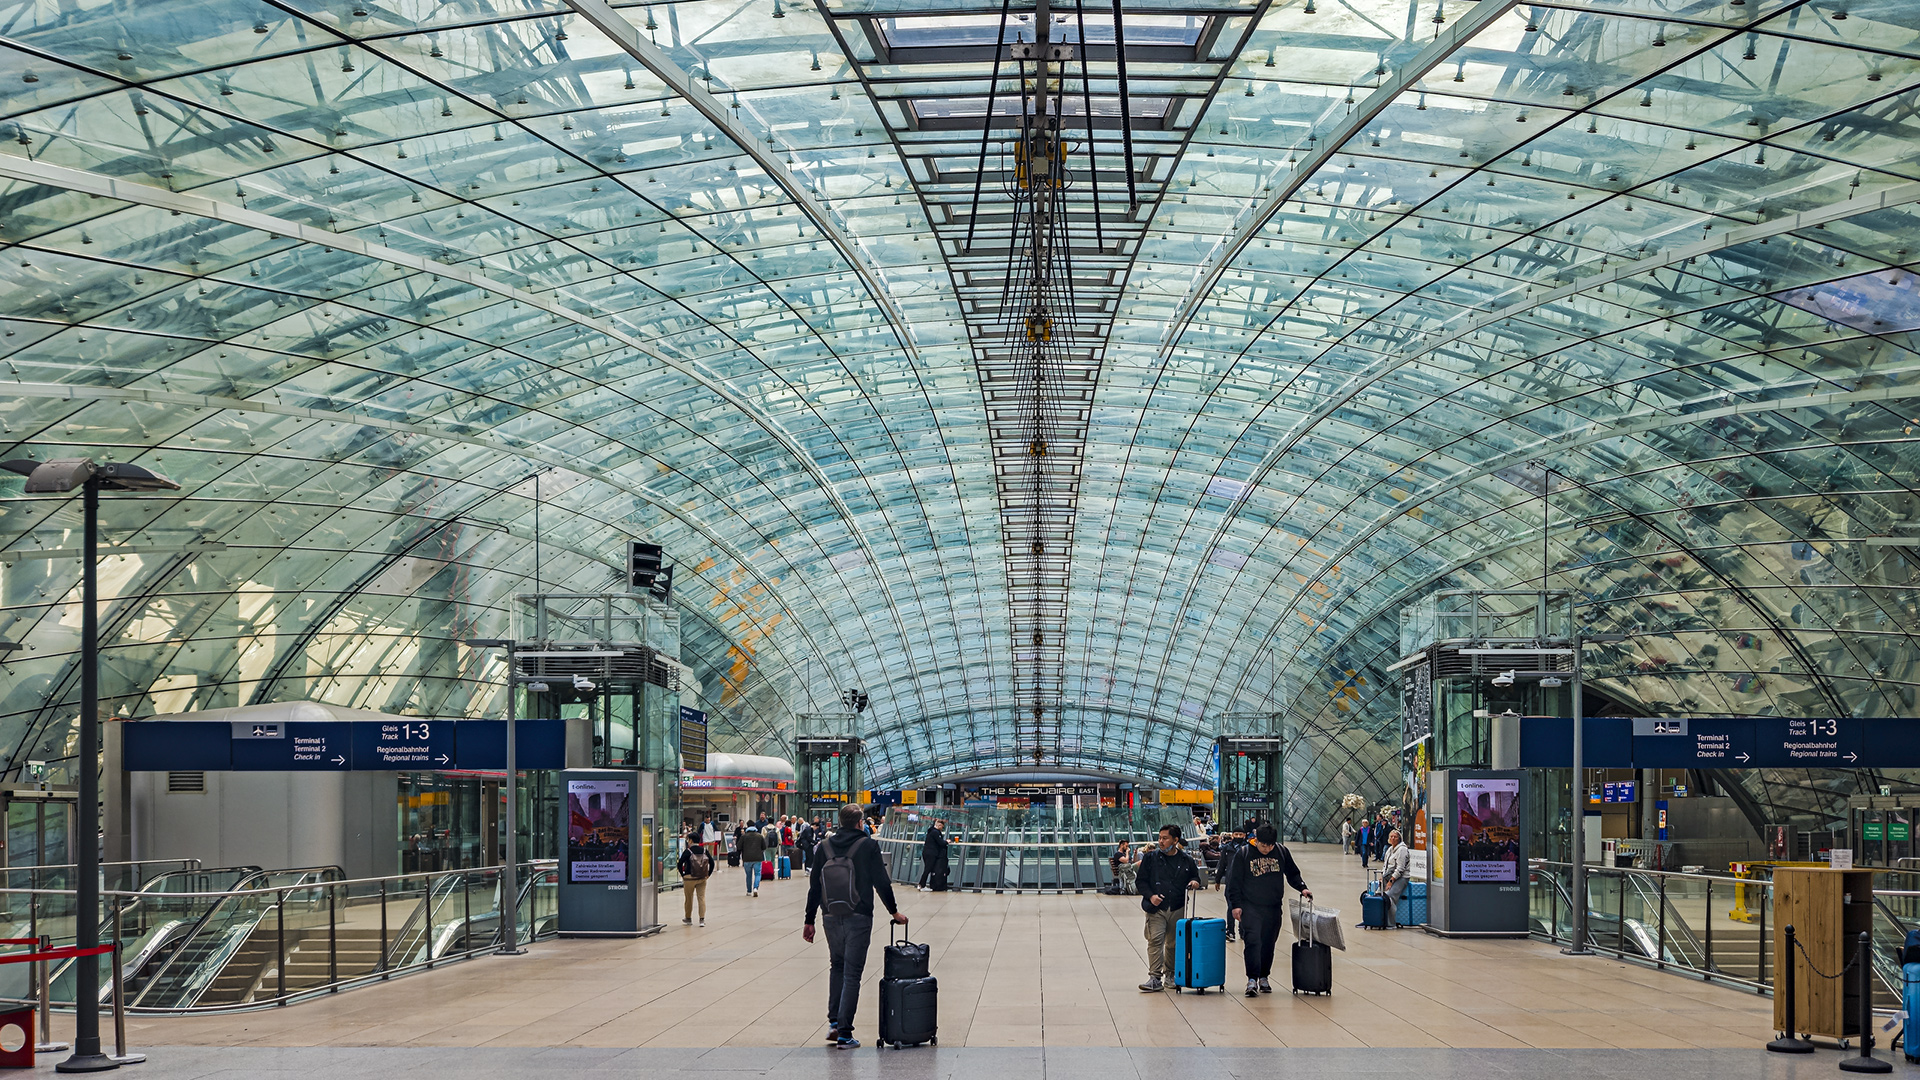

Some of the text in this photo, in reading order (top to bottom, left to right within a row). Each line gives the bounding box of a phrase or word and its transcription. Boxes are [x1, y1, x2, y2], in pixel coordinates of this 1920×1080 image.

[402, 723, 430, 740] 1-3
[1809, 719, 1838, 735] 1-3
[1784, 742, 1837, 750] Regionalbahnhof
[383, 754, 411, 762] Regional
